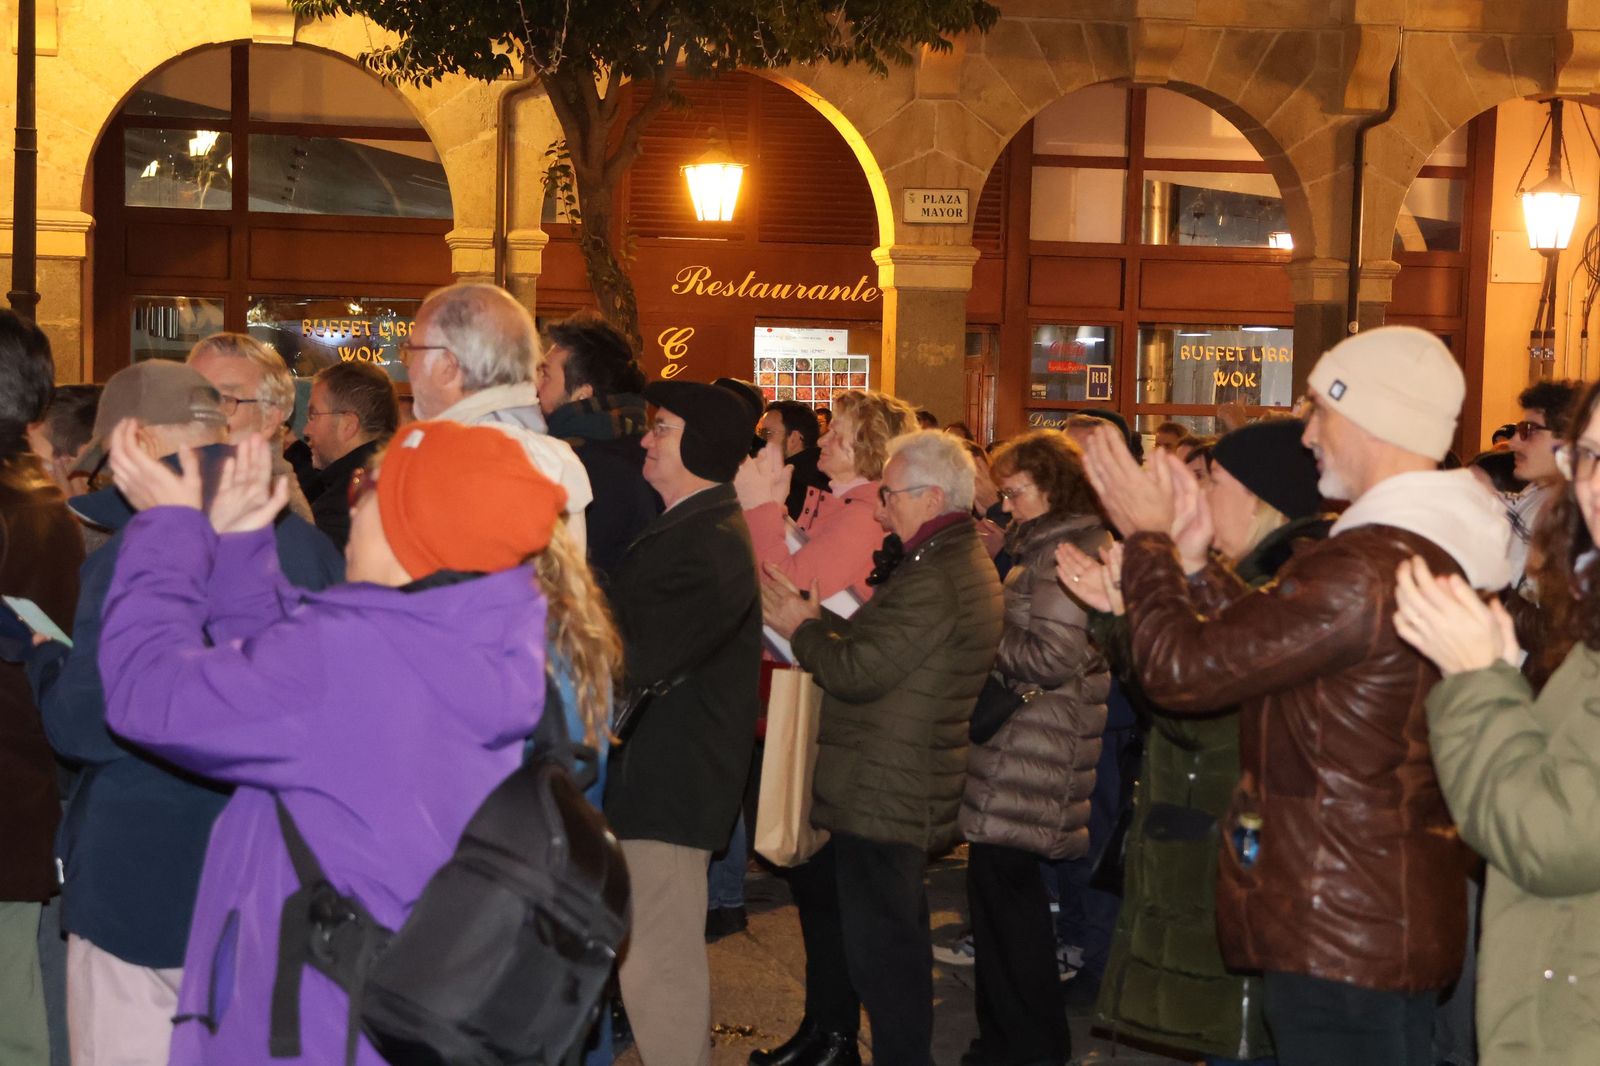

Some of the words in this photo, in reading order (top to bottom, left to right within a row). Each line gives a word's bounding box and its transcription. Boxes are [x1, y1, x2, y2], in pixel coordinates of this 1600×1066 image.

[922, 194, 961, 204] PLAZA
[921, 207, 963, 218] MAYOR
[671, 265, 880, 303] Restaurante
[302, 319, 372, 338] BUFFET
[337, 346, 384, 362] WOK
[1180, 345, 1246, 361] BUFFET
[1251, 346, 1294, 362] LIBR
[1091, 371, 1107, 384] RB
[1213, 370, 1257, 388] WOK
